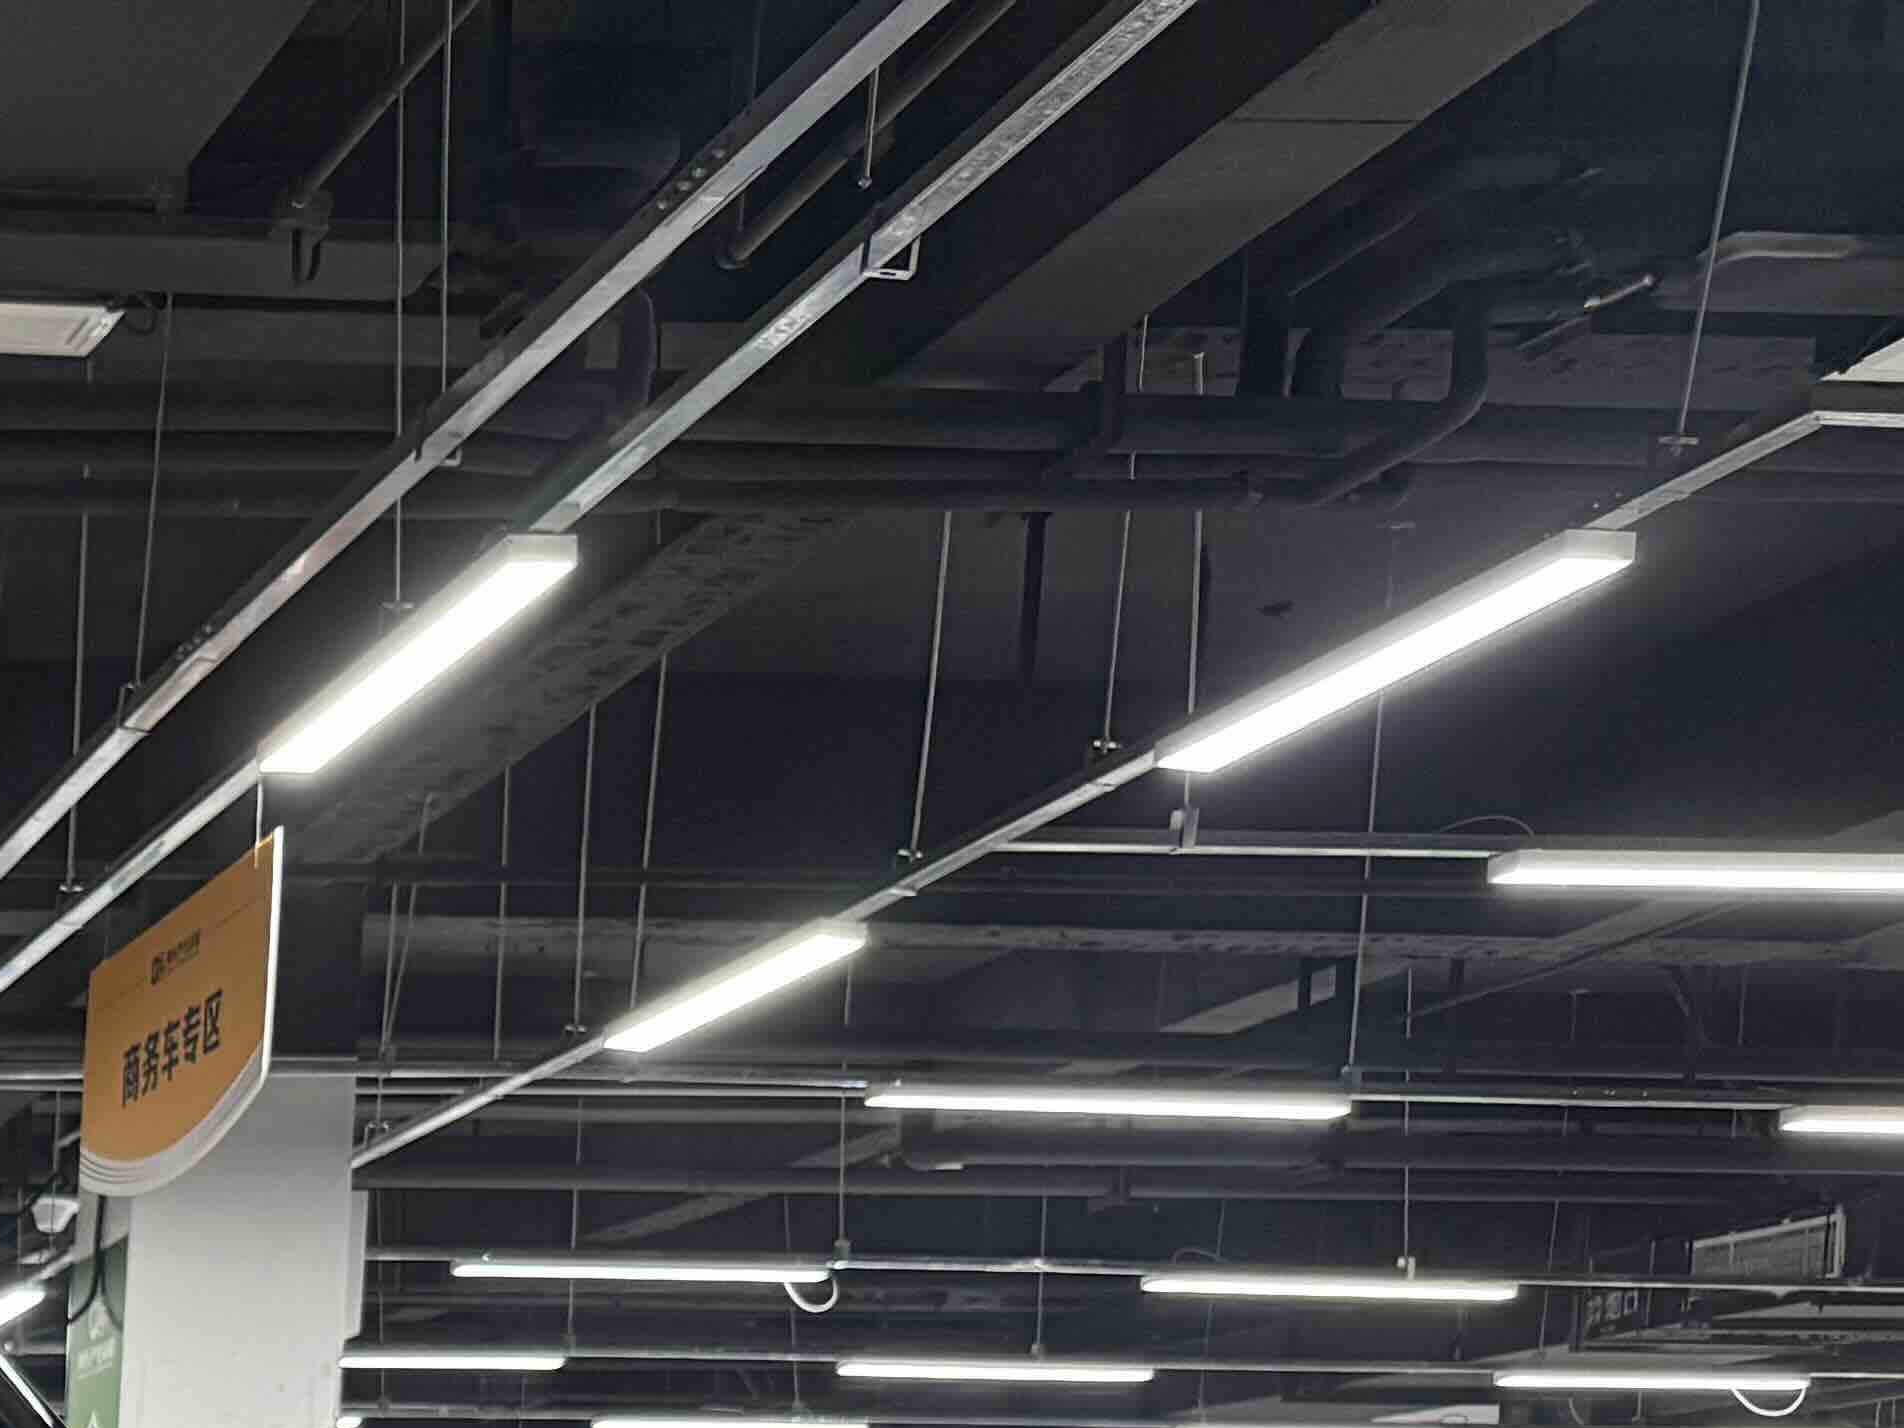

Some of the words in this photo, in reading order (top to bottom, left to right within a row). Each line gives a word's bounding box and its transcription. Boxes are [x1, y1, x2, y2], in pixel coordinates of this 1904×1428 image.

[122, 988, 223, 1109] 商务车专区
